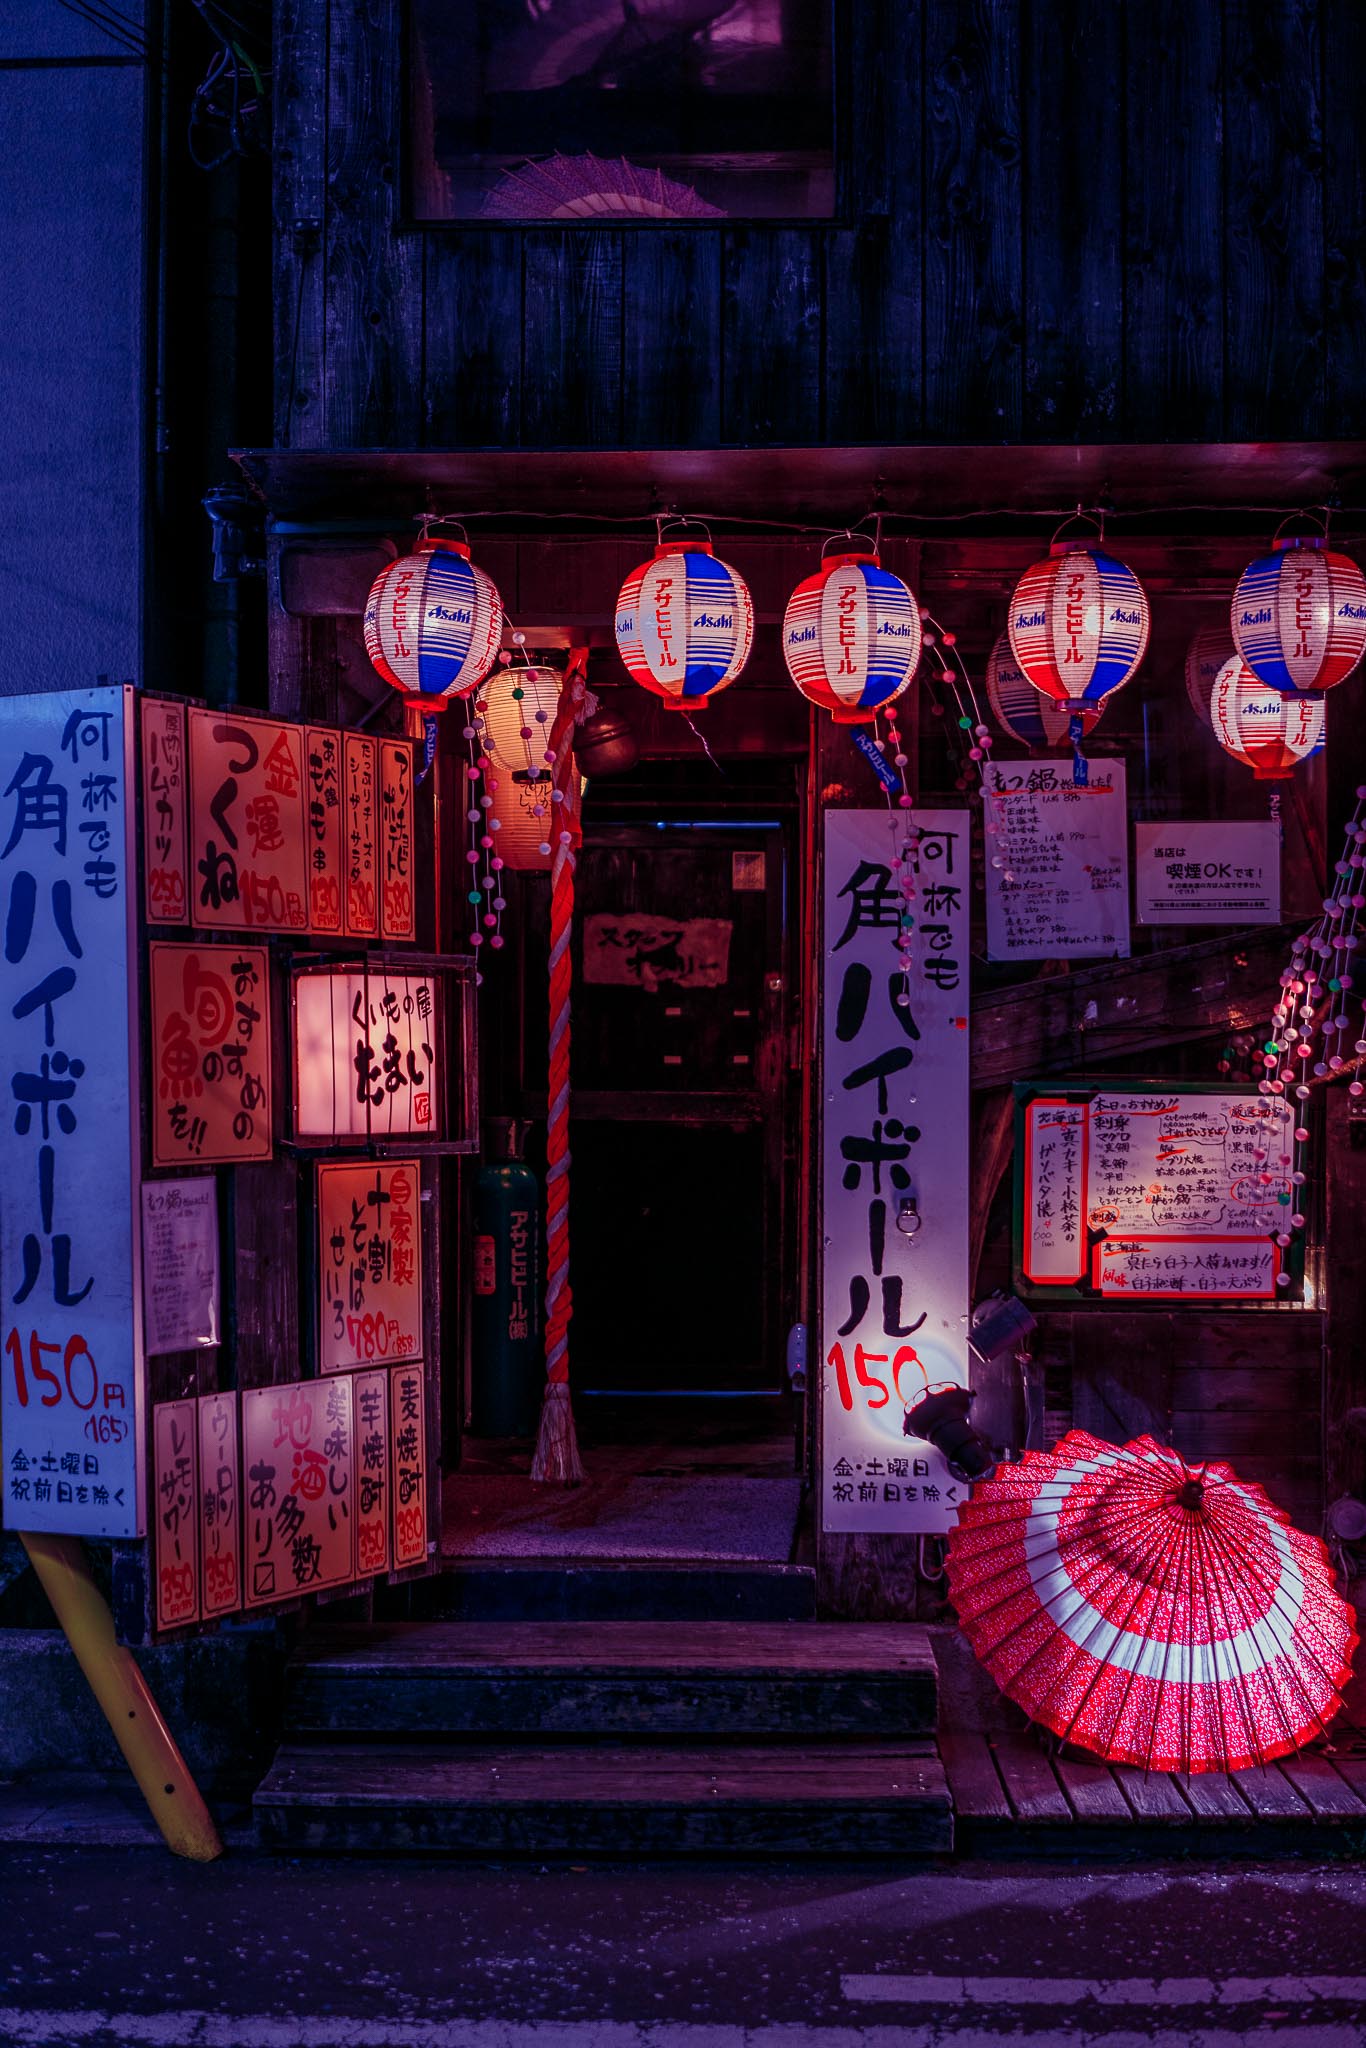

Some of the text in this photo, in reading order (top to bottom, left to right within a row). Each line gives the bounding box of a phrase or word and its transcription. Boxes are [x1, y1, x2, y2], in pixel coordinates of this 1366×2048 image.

[392, 571, 414, 658] アサヒビール
[428, 605, 471, 624] Asahi
[654, 578, 677, 667] アサヒビール
[693, 613, 732, 629] Asahi
[788, 625, 816, 645] Asahi
[837, 586, 858, 675] アサヒビール
[877, 621, 910, 638] Asahi
[1015, 611, 1046, 629] Asahi
[1063, 573, 1084, 664] アサヒビール
[1109, 607, 1140, 625] Asahi
[1240, 608, 1272, 626] Asahi
[1293, 568, 1313, 658] アサヒビール
[1218, 670, 1235, 746] アサヒビール
[1242, 703, 1281, 715] Asahi
[60, 709, 119, 899] 何杯でも
[245, 731, 299, 858] 金運
[361, 743, 373, 870] たっぷりチーズの
[991, 768, 1059, 794] もつ鍋
[198, 724, 259, 909] つくね
[349, 758, 362, 883] シーザーサラダ
[384, 784, 398, 881] ポテト
[1154, 848, 1186, 857] 当店は
[311, 876, 339, 914] 130
[349, 881, 375, 918] 580
[384, 880, 410, 921] 580
[902, 827, 961, 990] 何杯でも
[1, 752, 95, 1306] 角ハイボール
[352, 985, 433, 1031] くいもの屋
[222, 955, 267, 1141] おすすめの
[353, 1033, 435, 1107] たまい
[832, 860, 928, 1337] 角ハイボール
[1094, 1115, 1130, 1131] 刺身
[1096, 1132, 1131, 1142] マグロ
[1166, 1154, 1206, 1166] ブリ大根
[1098, 1196, 1143, 1206] とろサーモン
[1107, 1184, 1146, 1195] あじタタキ
[367, 1170, 392, 1285] 十割
[389, 1168, 415, 1287] 自家製
[326, 1226, 346, 1341] せいろ
[6, 1327, 125, 1410] 150円
[347, 1311, 400, 1360] 780円
[11, 1448, 99, 1475] 金・土曜日
[84, 1415, 128, 1443] (165)
[272, 1391, 330, 1502] 地酒
[324, 1386, 350, 1531] 美味しい
[360, 1388, 386, 1514] 芋焼酎
[396, 1376, 423, 1505] 麦焼酎
[11, 1477, 125, 1506] 祝前日を除く
[170, 1419, 192, 1520] レモン
[212, 1404, 235, 1527] ウーロン
[833, 1457, 929, 1478] 金・土曜日
[833, 1483, 960, 1504] 祝前日を除く
[160, 1474, 182, 1561] サワー
[204, 1489, 222, 1556] 割り
[276, 1494, 323, 1587] 多数
[359, 1520, 386, 1558] 350
[396, 1506, 424, 1546] 380
[160, 1562, 194, 1606] 350
[205, 1552, 236, 1594] 350
